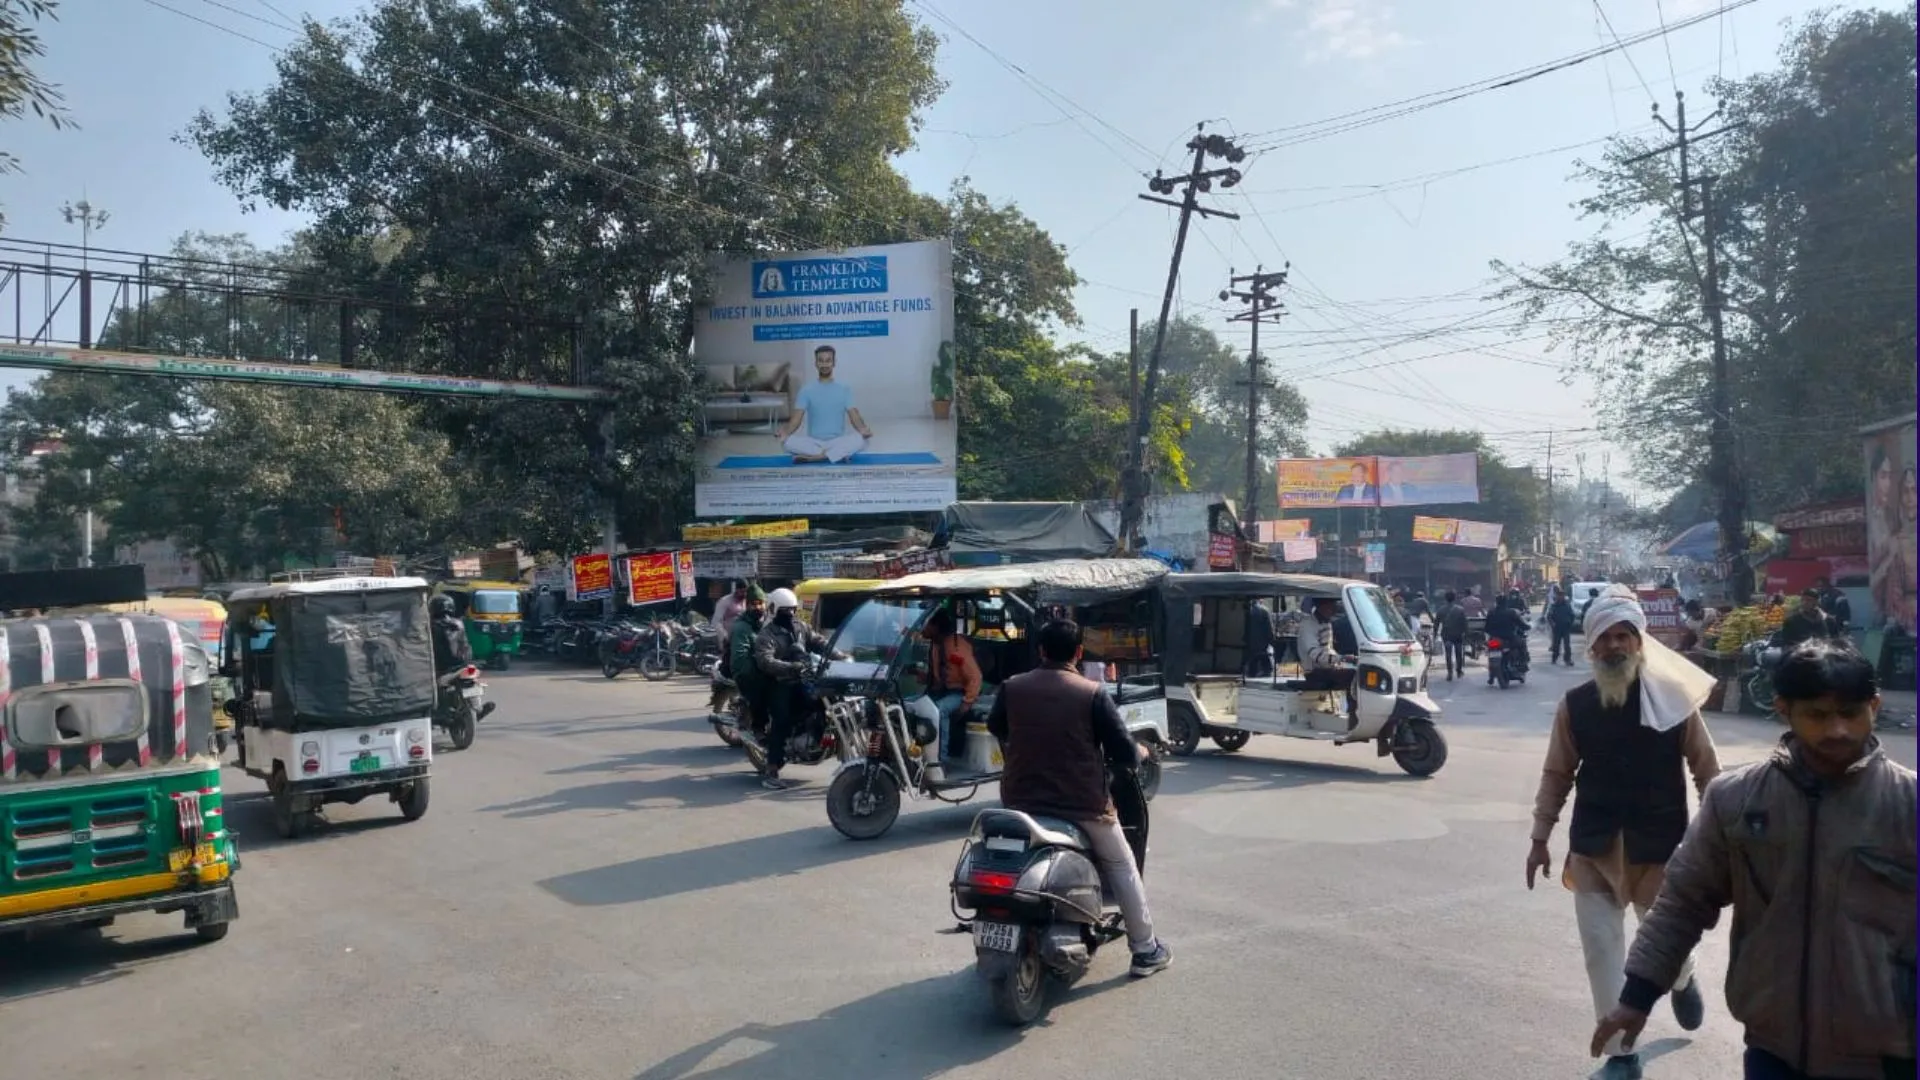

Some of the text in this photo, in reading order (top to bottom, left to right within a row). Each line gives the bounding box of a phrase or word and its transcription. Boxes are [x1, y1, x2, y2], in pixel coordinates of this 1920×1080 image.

[791, 260, 869, 277] FRANKLIN
[791, 276, 882, 293] TEMPLETON
[709, 305, 748, 321] INVEST
[751, 304, 761, 319] IN
[765, 302, 822, 318] BALANCED
[826, 299, 889, 316] ADVANTAGE
